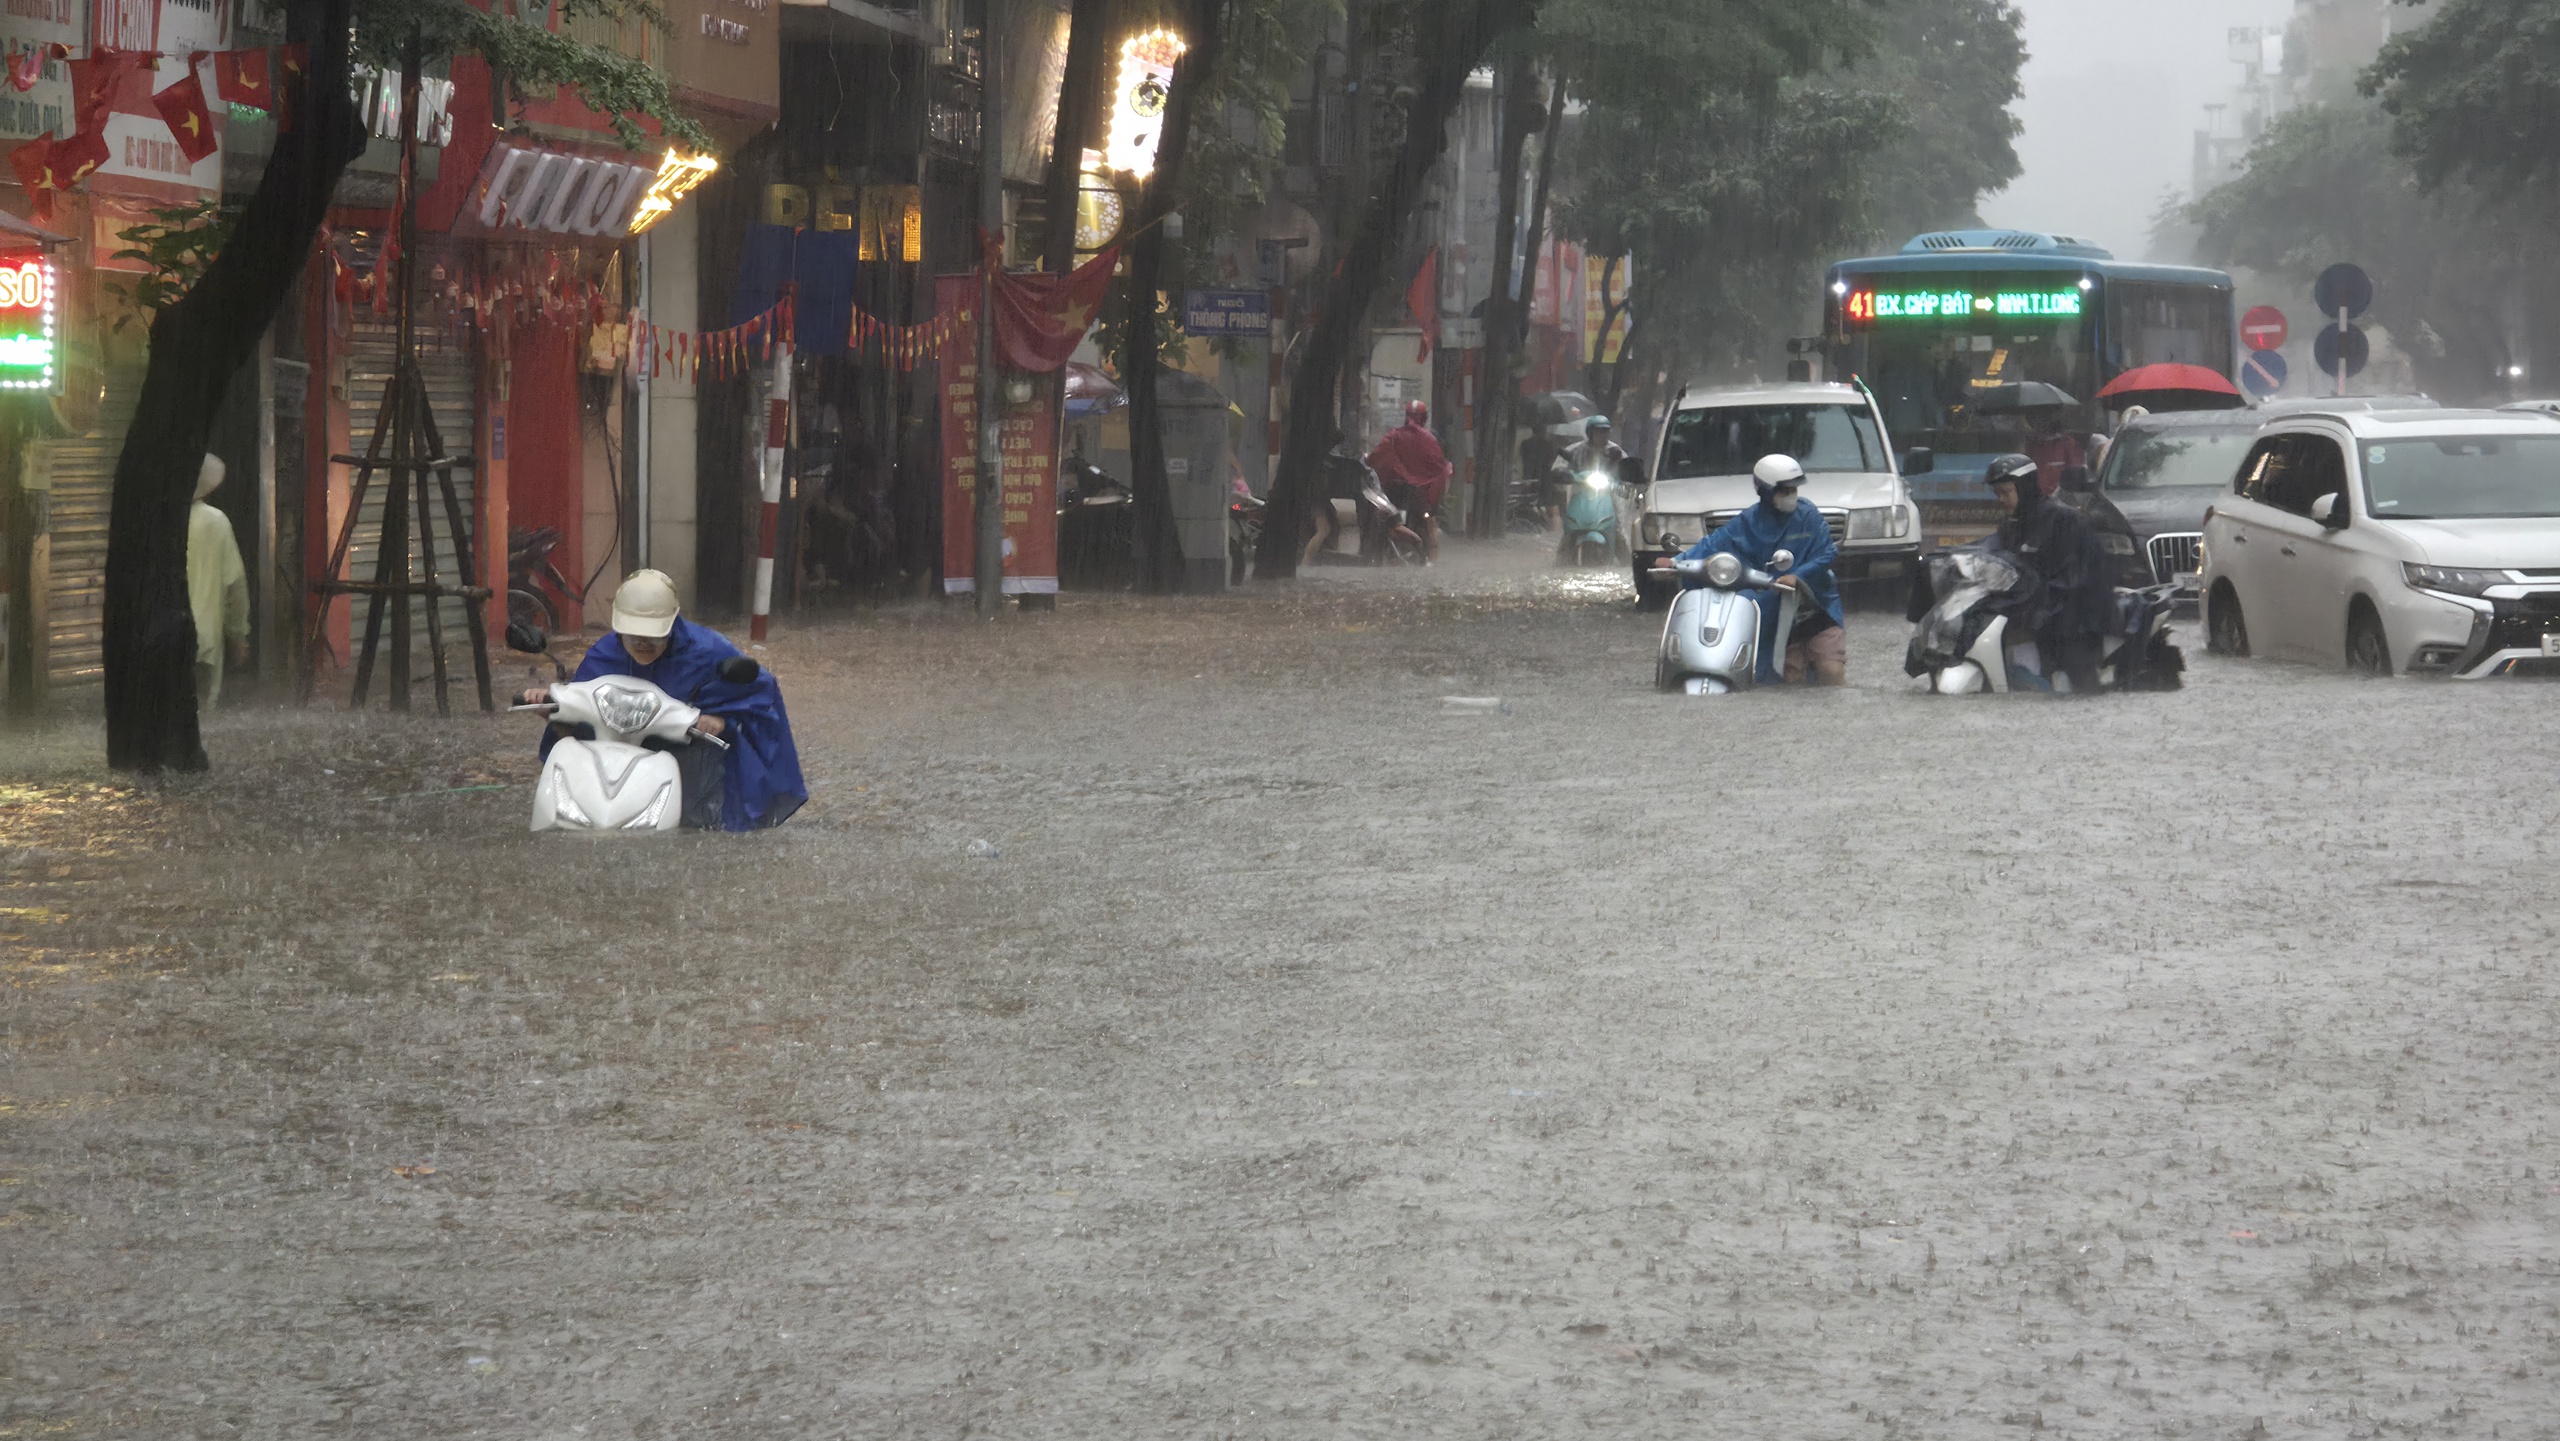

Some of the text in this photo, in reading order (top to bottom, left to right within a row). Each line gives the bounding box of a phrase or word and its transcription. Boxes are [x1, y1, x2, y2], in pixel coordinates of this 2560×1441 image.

[1850, 292, 1874, 317] 41
[1941, 290, 1973, 314] BÁT
[1229, 312, 1268, 328] PHONG
